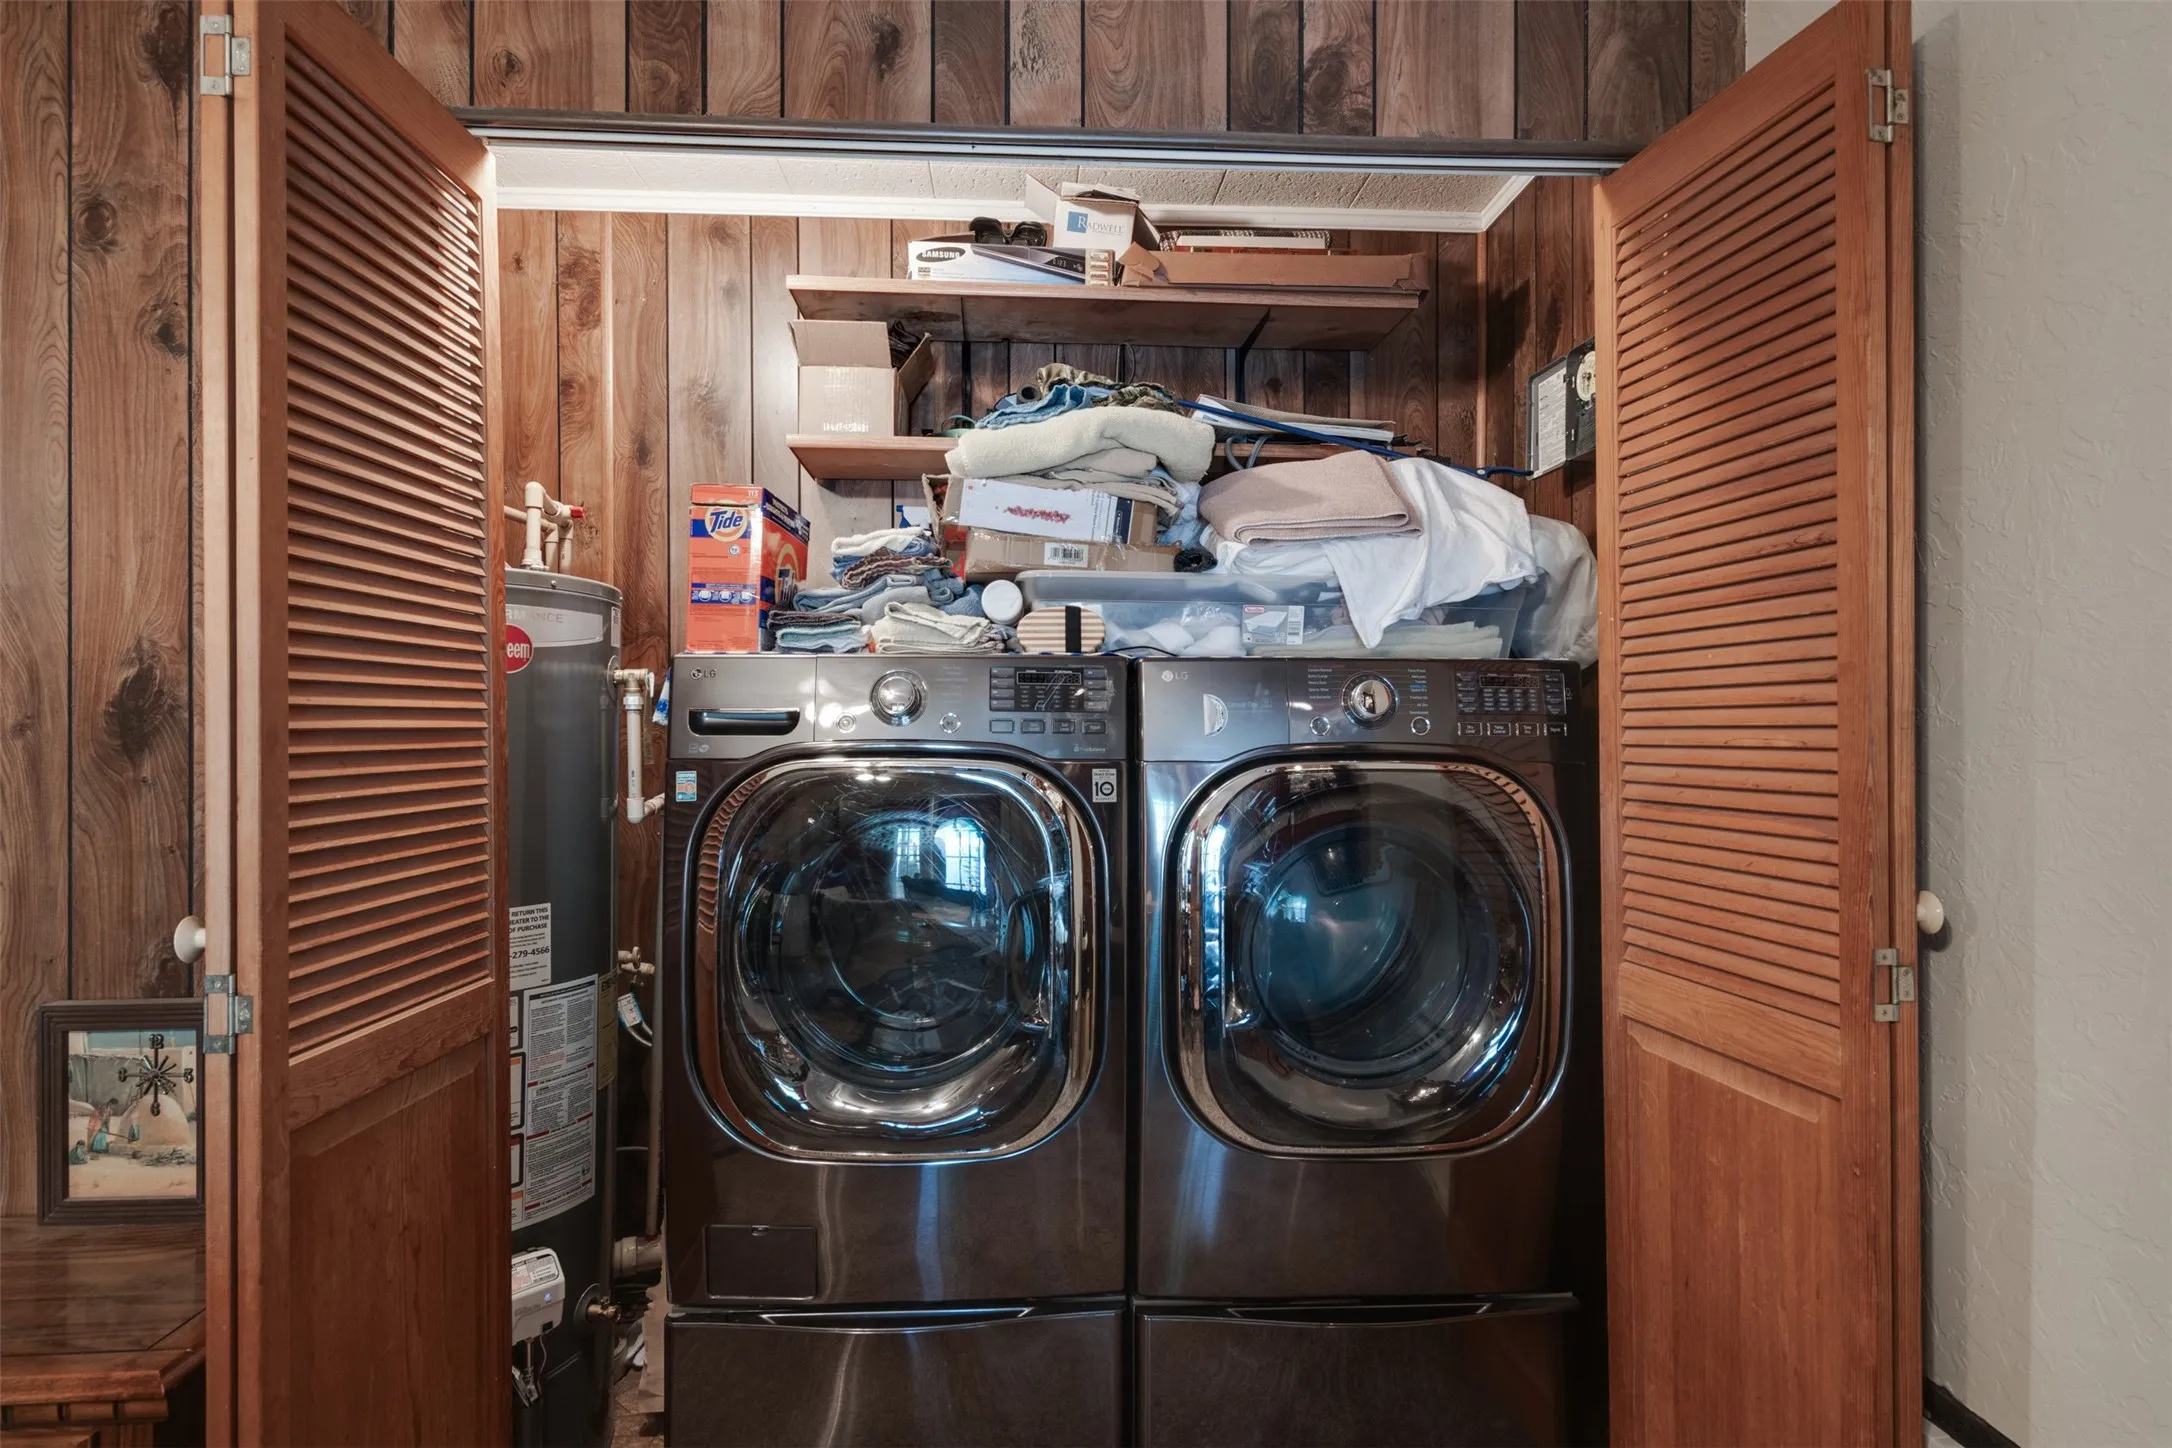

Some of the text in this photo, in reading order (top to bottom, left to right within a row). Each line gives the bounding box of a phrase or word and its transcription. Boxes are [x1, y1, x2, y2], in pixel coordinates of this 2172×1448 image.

[1077, 215, 1125, 235] RADWELL
[922, 249, 961, 260] SAMSUNG
[710, 510, 744, 534] Tide
[1094, 781, 1115, 797] 10
[511, 907, 549, 918] RETURN THIS
[530, 915, 539, 923] TO
[539, 914, 550, 922] THE
[517, 922, 548, 933] PURCHASE
[149, 1033, 165, 1050] 12
[183, 1067, 194, 1084] 3
[149, 1101, 161, 1117] 6
